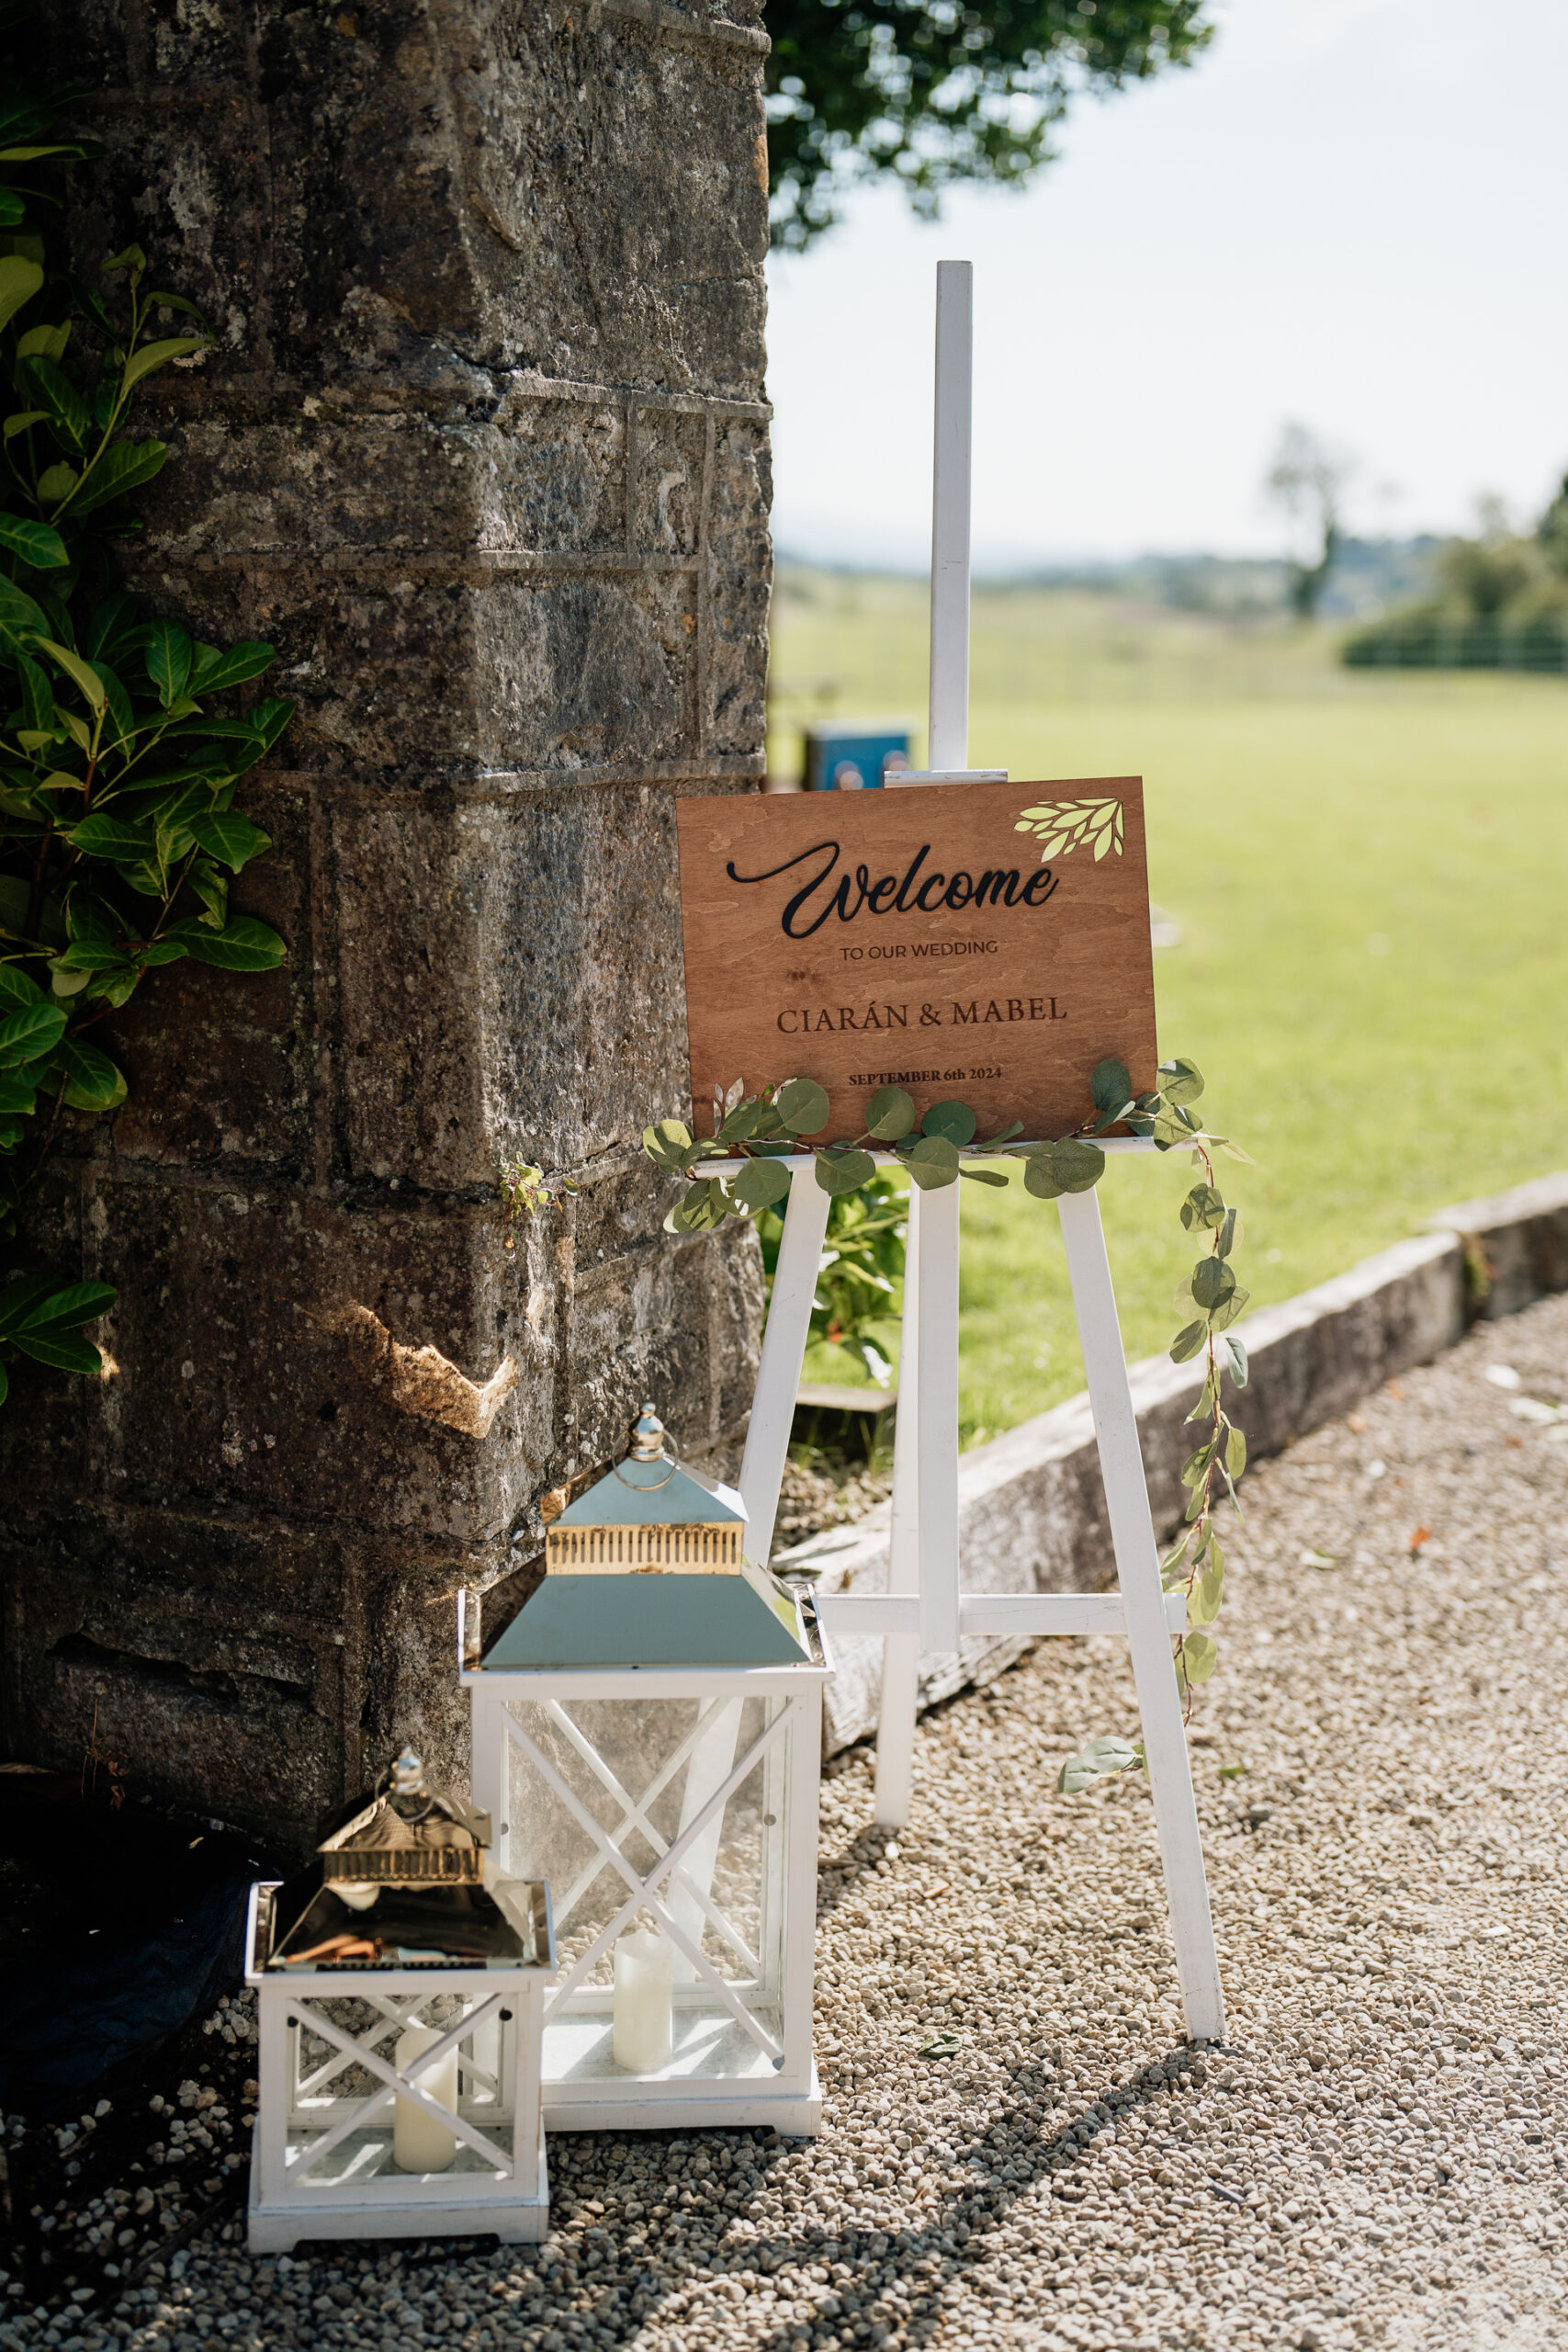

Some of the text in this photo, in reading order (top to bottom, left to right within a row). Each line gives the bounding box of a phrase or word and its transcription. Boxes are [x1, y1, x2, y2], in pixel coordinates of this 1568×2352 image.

[726, 841, 1060, 940] Welcome
[840, 940, 998, 961] TO OUR WEDDING
[777, 997, 1067, 1034] CIARÁN & MABEL
[849, 1068, 1003, 1086] SEPTEMBER 6th 2024
